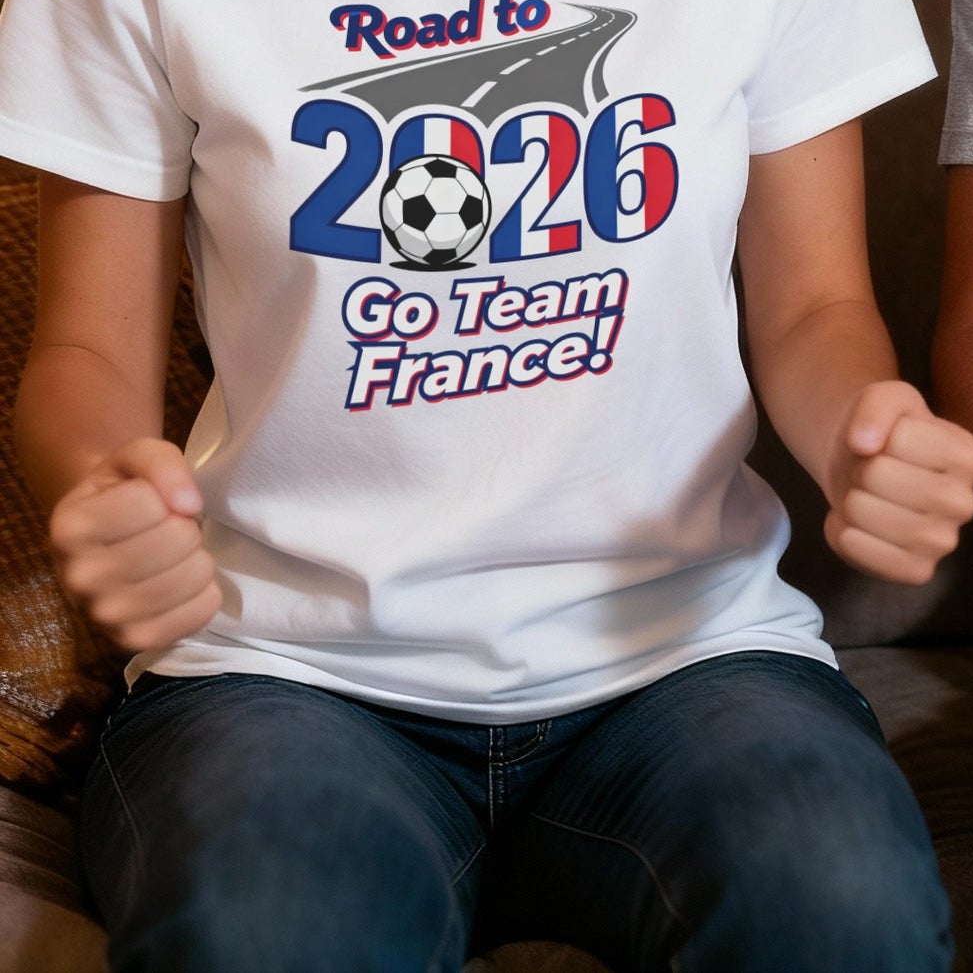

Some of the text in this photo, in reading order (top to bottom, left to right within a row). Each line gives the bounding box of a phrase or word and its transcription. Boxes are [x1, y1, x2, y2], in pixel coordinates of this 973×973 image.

[341, 267, 629, 342] Go Team
[344, 308, 625, 412] France!
